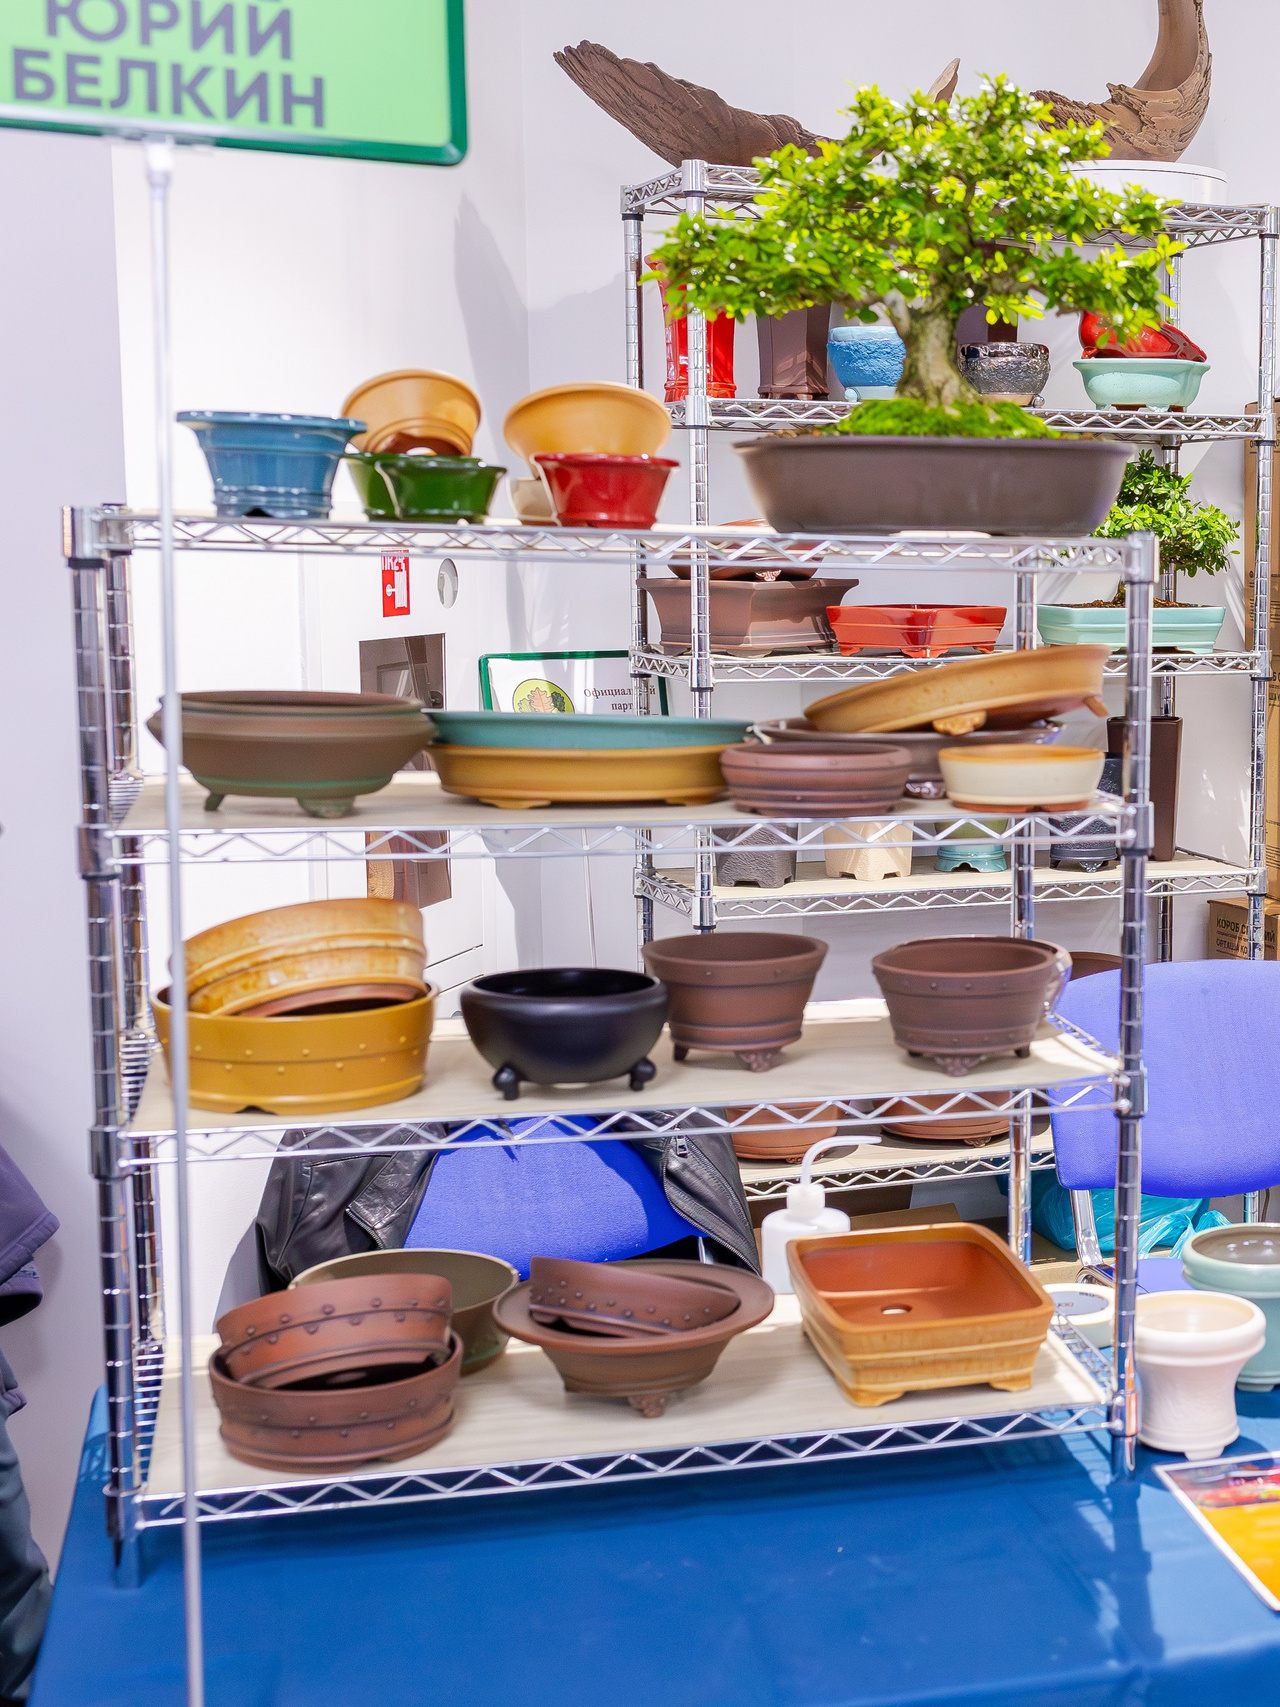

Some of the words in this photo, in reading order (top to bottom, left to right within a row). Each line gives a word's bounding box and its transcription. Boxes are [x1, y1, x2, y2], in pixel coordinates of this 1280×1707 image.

[46, 0, 292, 60] ЮРИЙ
[13, 48, 325, 128] БЕЛКИН
[583, 685, 656, 699] Официалй
[611, 702, 634, 713] парт
[1216, 917, 1240, 933] КОРОБ
